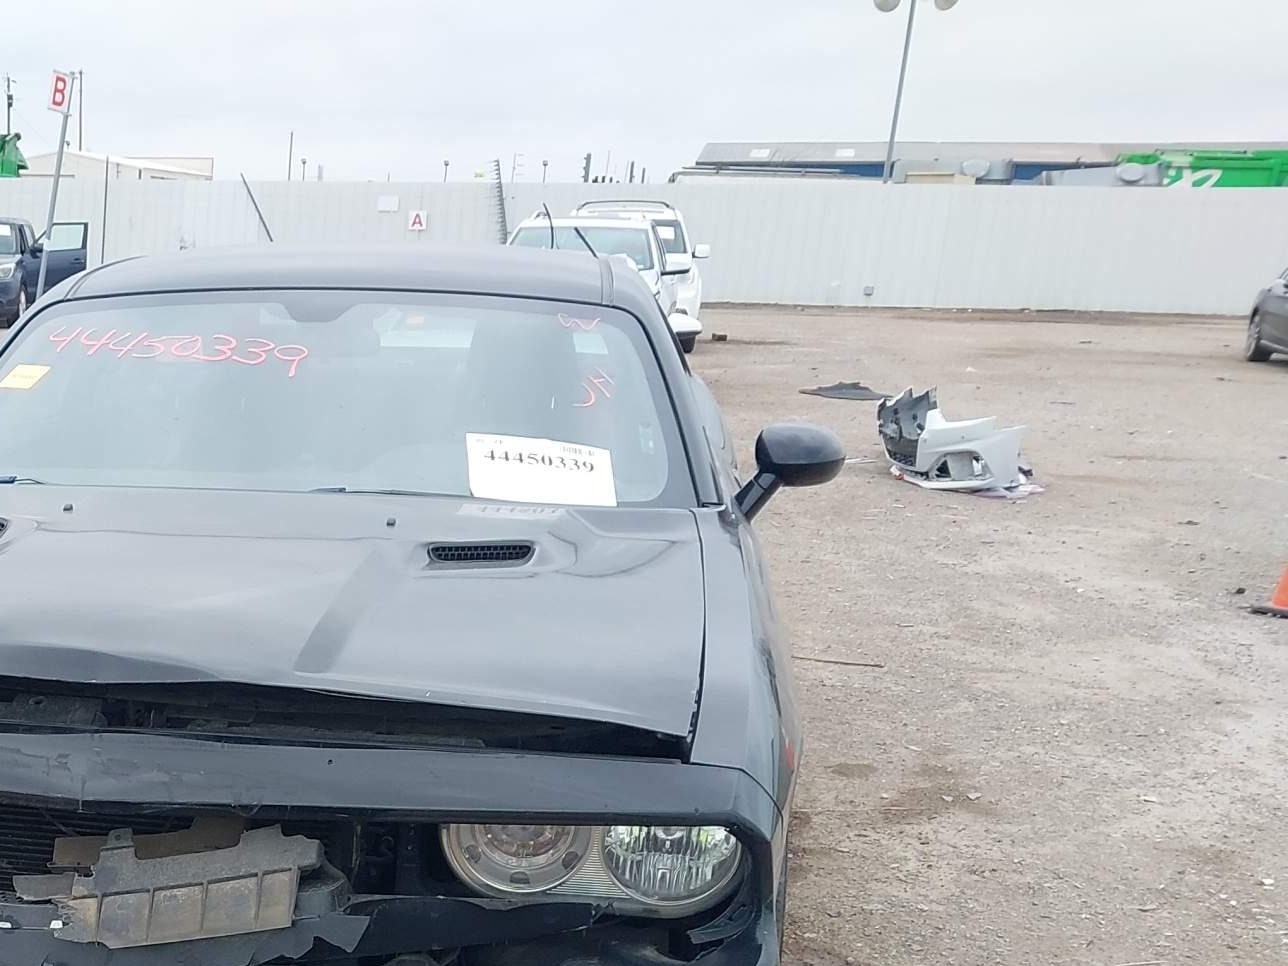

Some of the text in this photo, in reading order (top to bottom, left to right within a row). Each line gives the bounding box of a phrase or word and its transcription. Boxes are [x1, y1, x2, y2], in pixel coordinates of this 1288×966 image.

[52, 75, 67, 106] B
[411, 213, 423, 227] A
[49, 326, 309, 377] 44450339
[484, 449, 595, 473] 44450339
